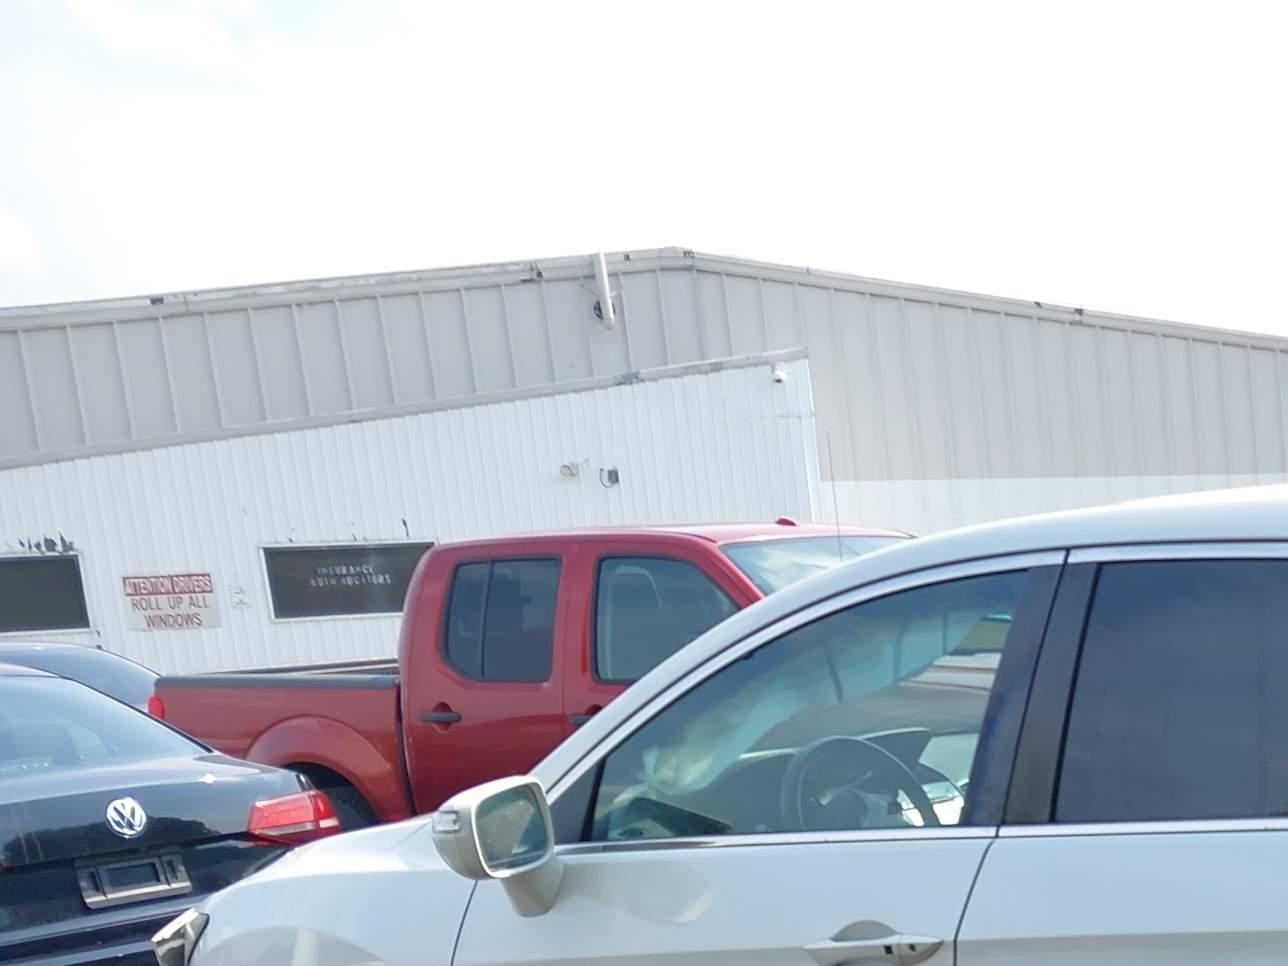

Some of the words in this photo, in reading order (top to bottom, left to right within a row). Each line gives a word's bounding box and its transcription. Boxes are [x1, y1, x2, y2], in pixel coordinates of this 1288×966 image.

[131, 597, 162, 612] ROLL
[168, 596, 184, 610] UP
[188, 595, 210, 609] ALL
[144, 613, 203, 629] WINDOWS
